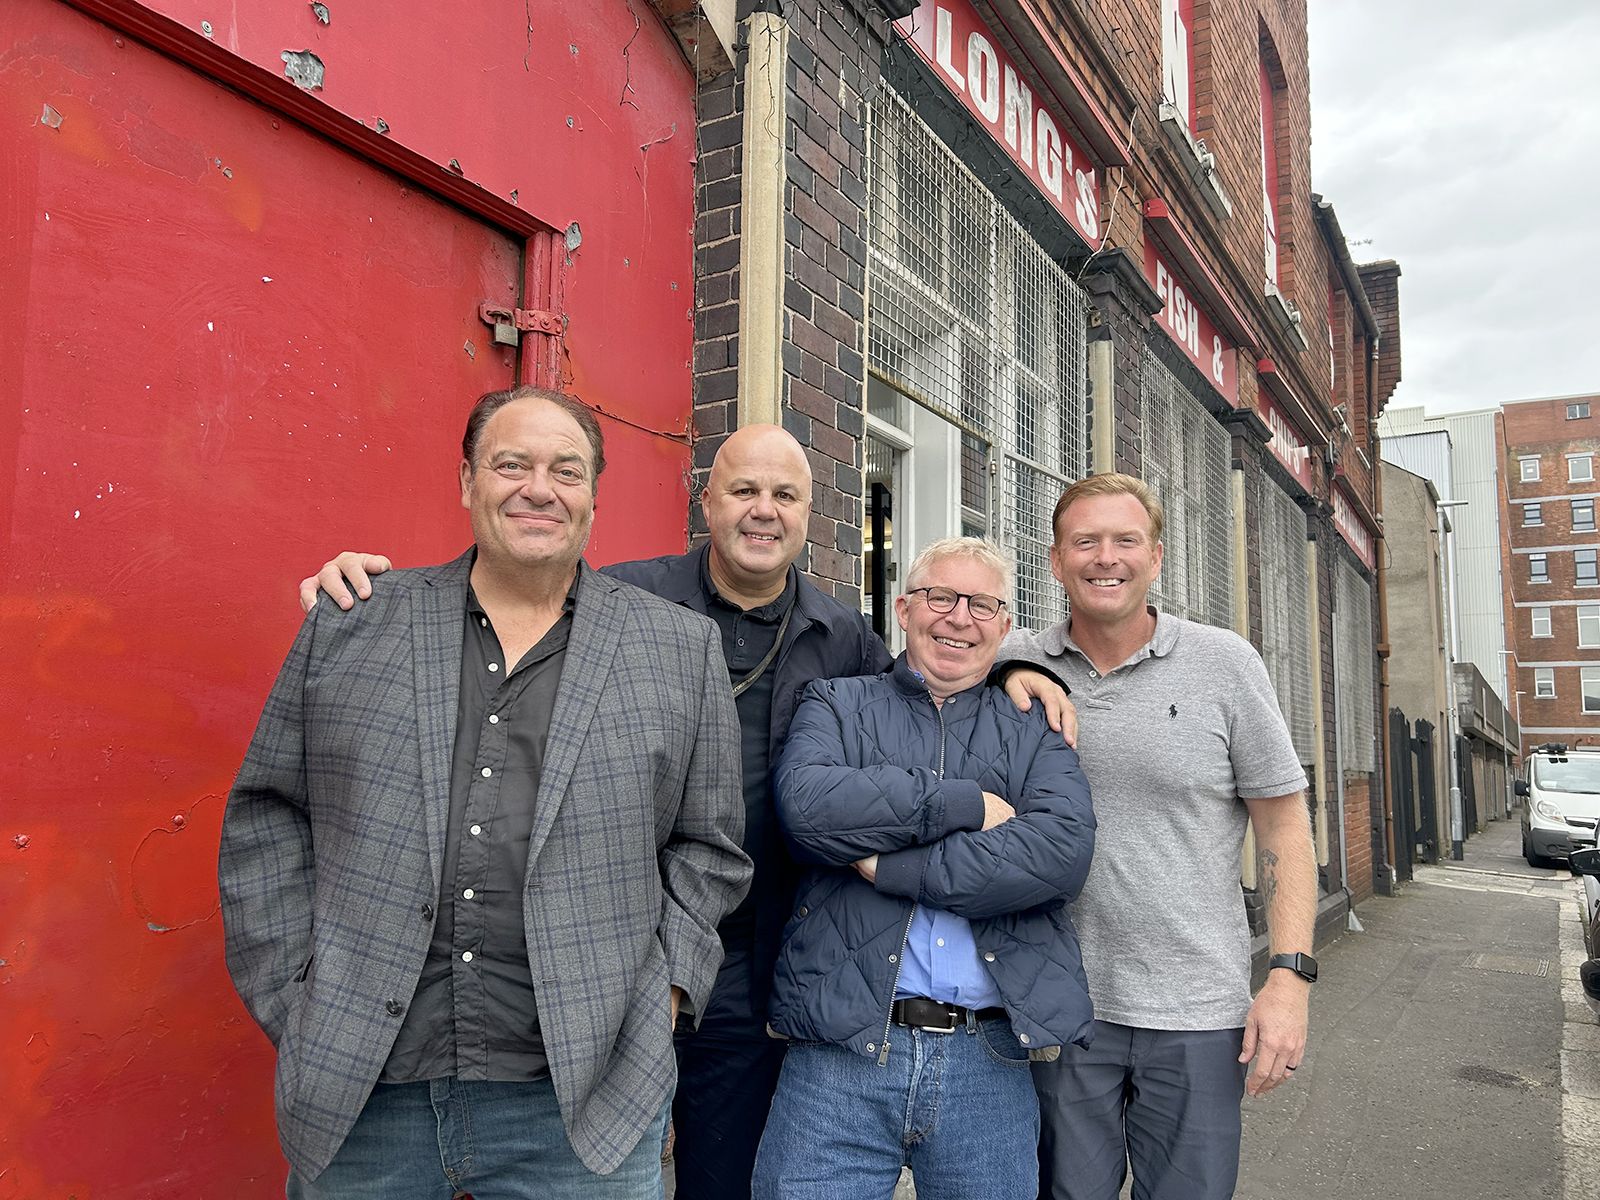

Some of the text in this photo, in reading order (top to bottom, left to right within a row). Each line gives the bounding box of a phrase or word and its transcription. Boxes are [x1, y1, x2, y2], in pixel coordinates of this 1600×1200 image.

[936, 6, 1098, 240] LONG'S
[1156, 259, 1224, 387] FISH &
[1269, 406, 1300, 475] CHIPS
